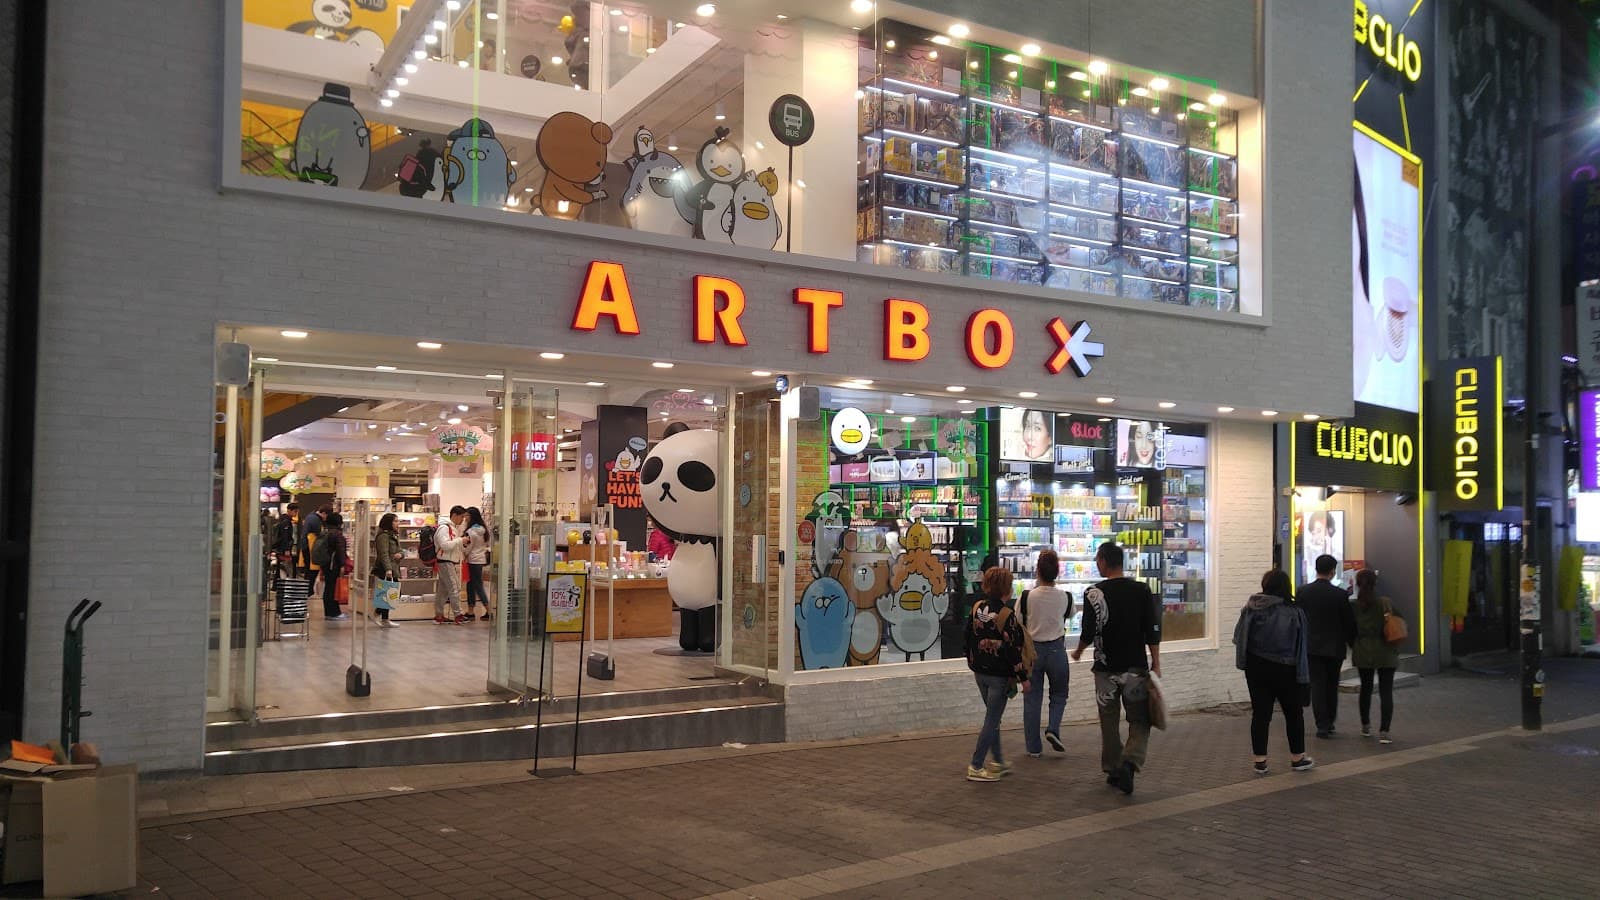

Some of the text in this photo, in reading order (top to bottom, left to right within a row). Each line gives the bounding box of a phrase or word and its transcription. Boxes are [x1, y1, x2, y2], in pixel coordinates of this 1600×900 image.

[785, 128, 800, 138] BUS
[571, 260, 1105, 377] ARTBOX
[1316, 421, 1413, 467] CLUBCLIO
[1455, 367, 1479, 500] CLUBCLIO
[608, 470, 640, 482] LET'S
[608, 495, 643, 509] FUN!
